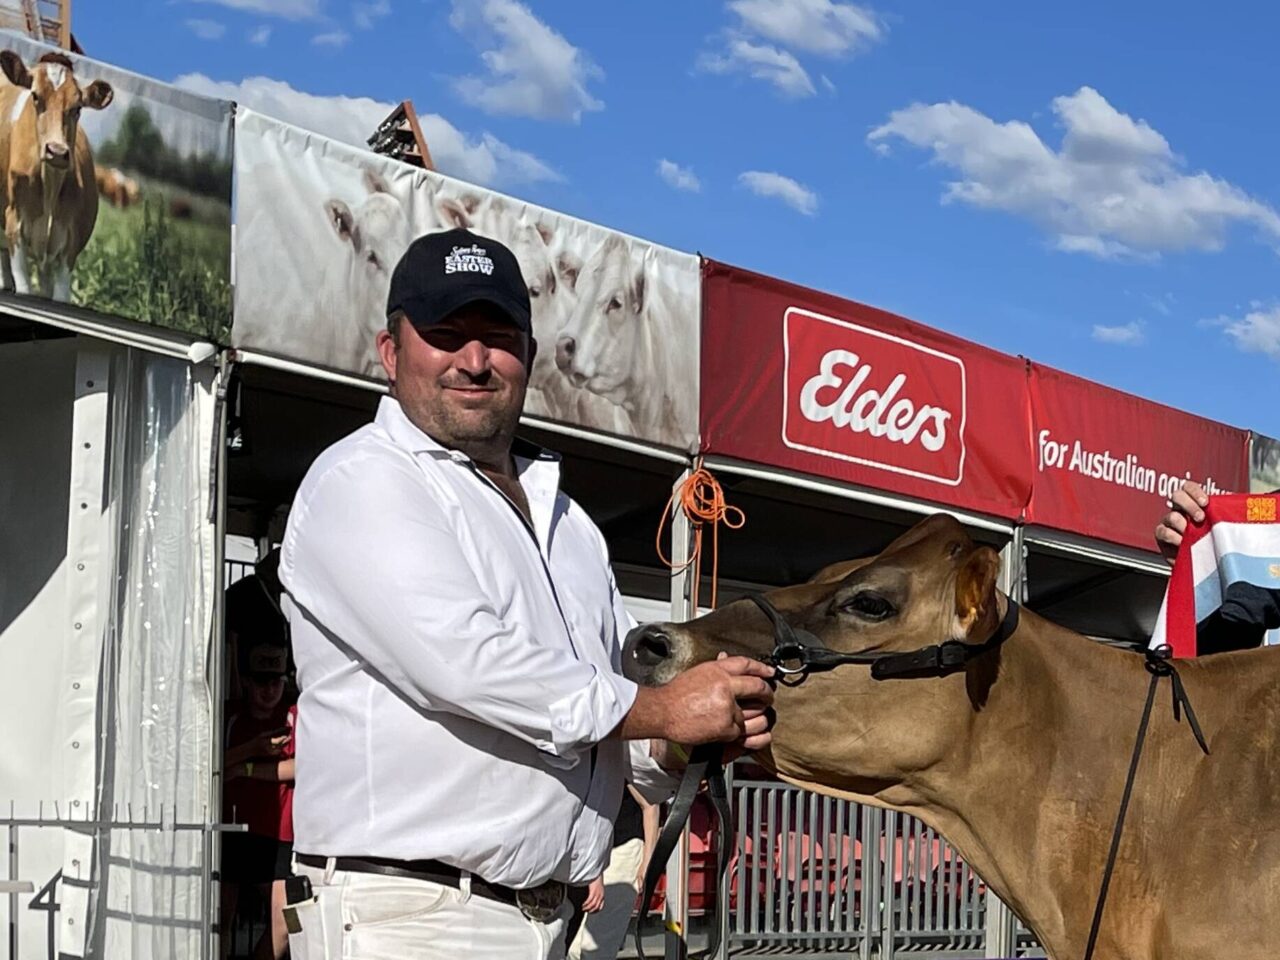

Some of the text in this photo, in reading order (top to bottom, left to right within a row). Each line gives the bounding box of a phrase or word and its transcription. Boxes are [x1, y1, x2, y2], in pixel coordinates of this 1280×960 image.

[445, 263, 494, 275] SHOW
[800, 349, 951, 451] Elders
[1039, 430, 1069, 472] for
[1069, 440, 1156, 494] Australian
